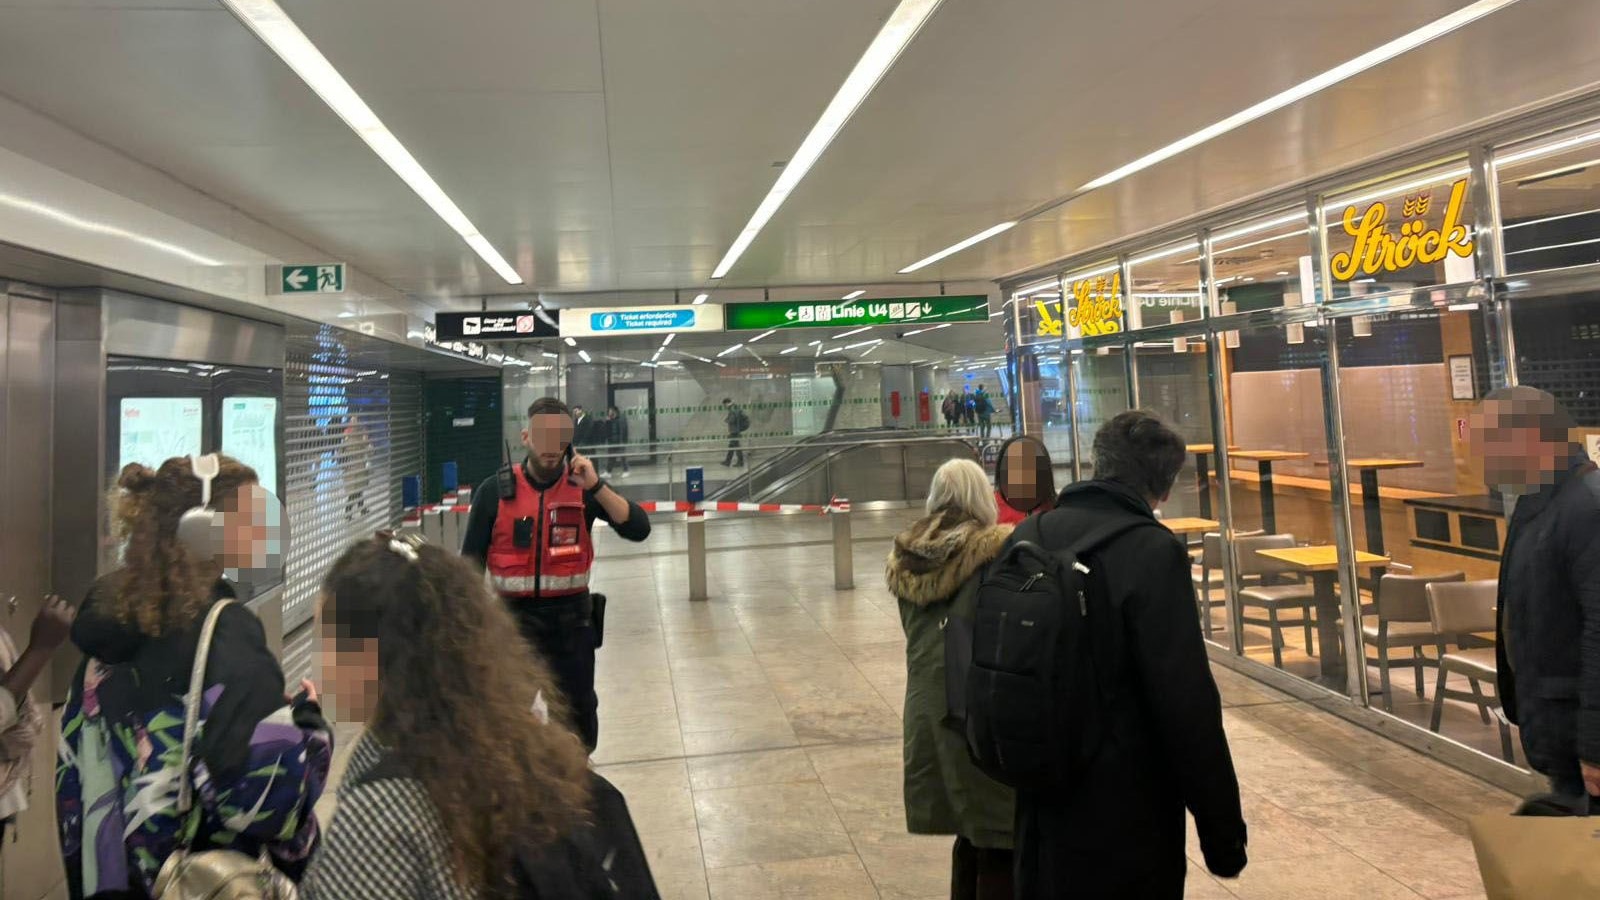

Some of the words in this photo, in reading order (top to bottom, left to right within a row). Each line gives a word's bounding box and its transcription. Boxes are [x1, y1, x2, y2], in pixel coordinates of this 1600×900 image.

[1331, 178, 1473, 281] Ströck
[1069, 272, 1122, 327] Ströck
[639, 312, 677, 320] erforderlich
[832, 304, 865, 318] Linie
[868, 303, 888, 317] U4
[645, 319, 673, 327] required
